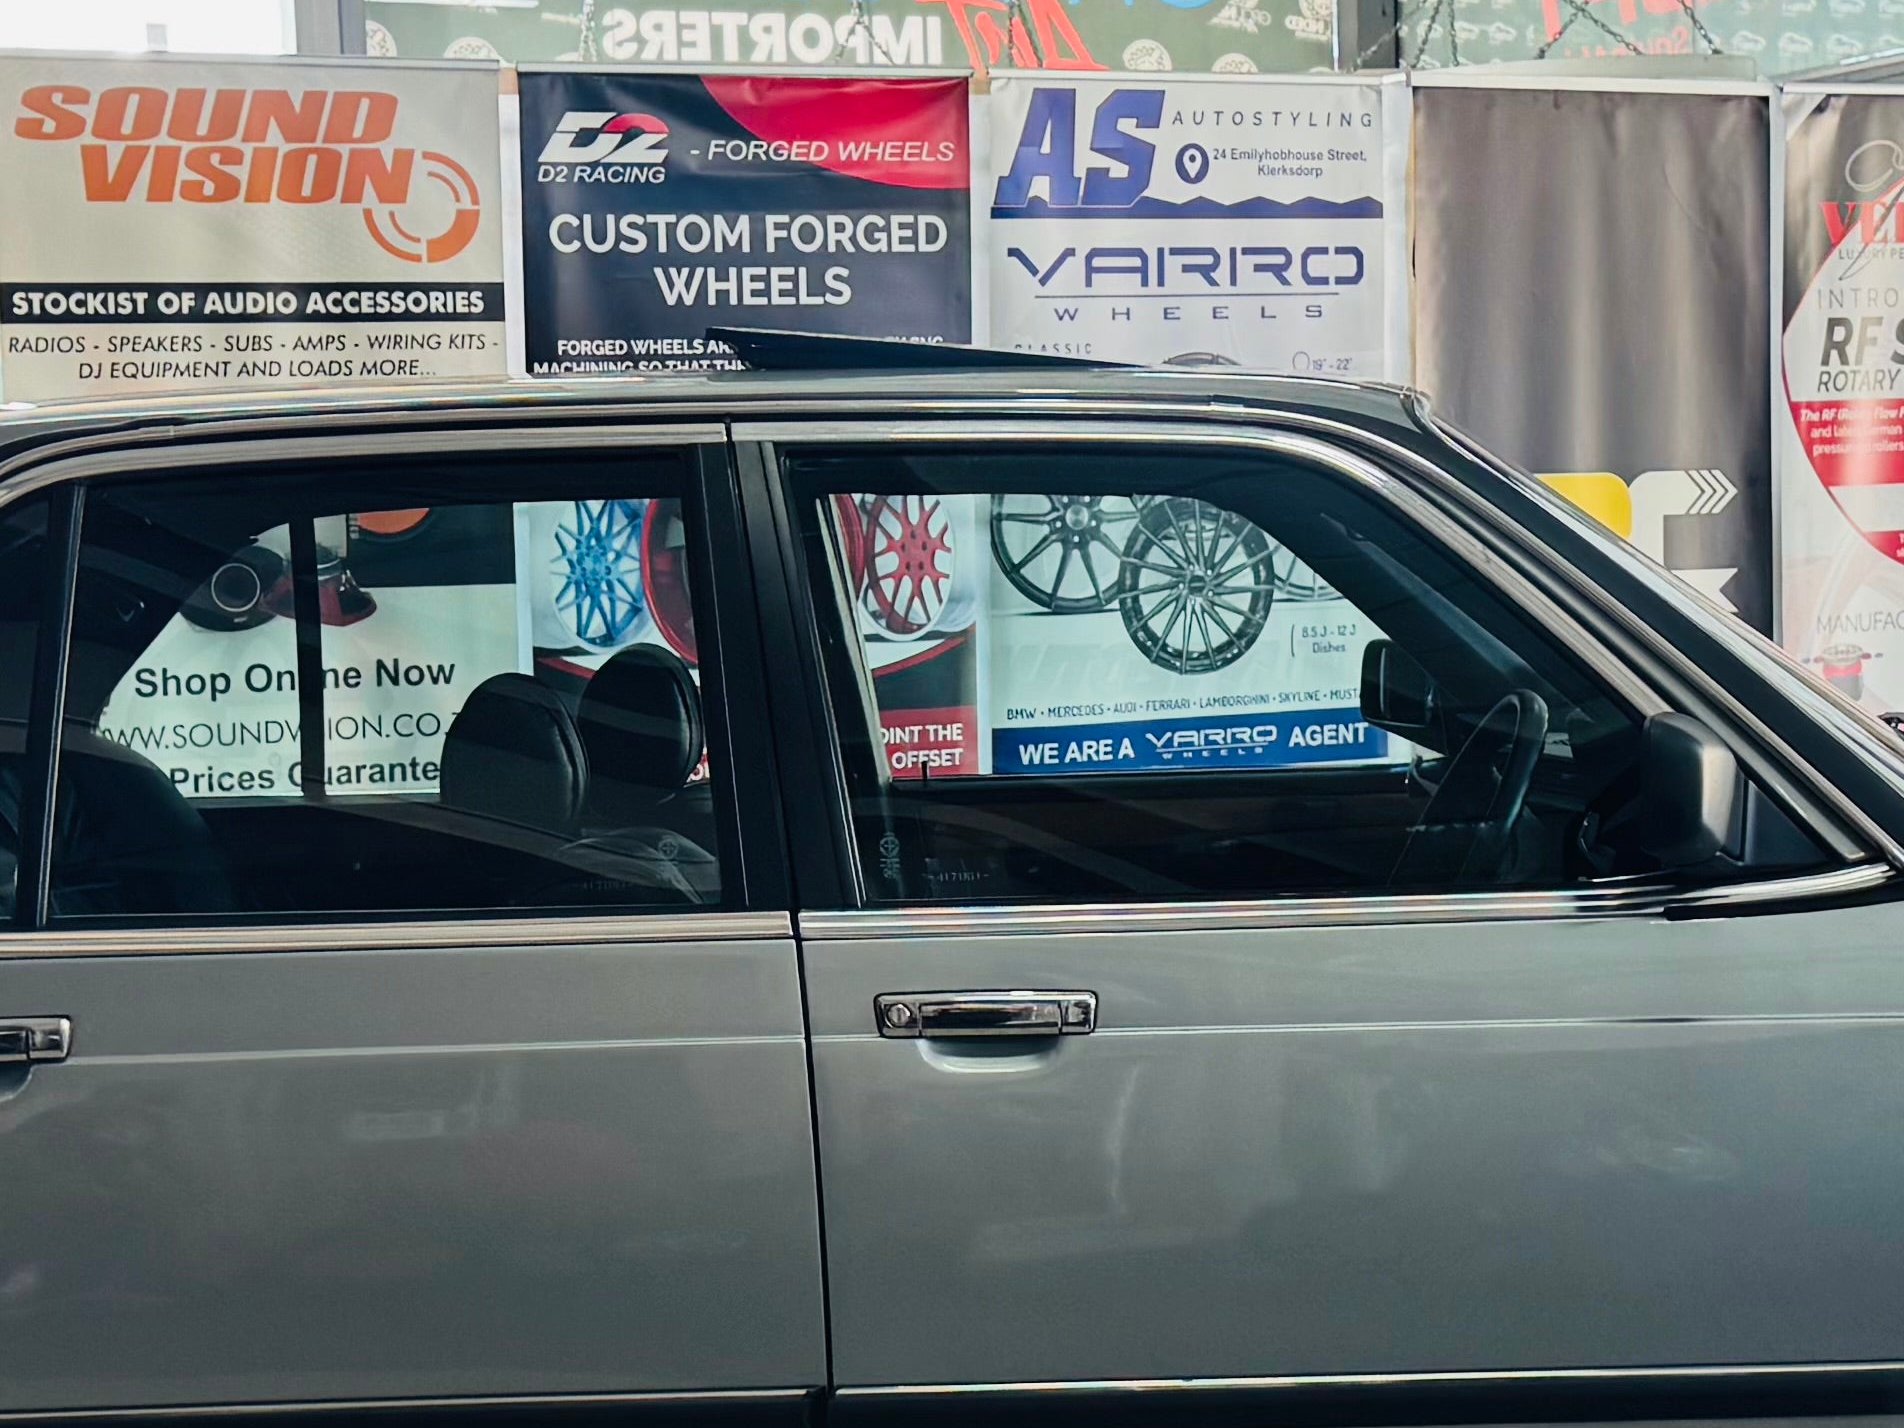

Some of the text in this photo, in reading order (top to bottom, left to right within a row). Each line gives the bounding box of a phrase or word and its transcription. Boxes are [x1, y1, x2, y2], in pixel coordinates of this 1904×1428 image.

[15, 84, 399, 144] SOUND
[1172, 110, 1374, 128] AUTOSTYLING
[537, 110, 670, 164] D2
[993, 87, 1166, 207] AS
[708, 139, 955, 163] FORGED WHEELS
[1213, 148, 1367, 164] 24 Emilyhobhouse Street,
[80, 143, 415, 204] VISION
[538, 166, 667, 184] D2 RACING
[1257, 164, 1324, 179] Klerksdorp
[548, 213, 949, 254] CUSTOM FORGED
[1007, 245, 1365, 289] VARRO
[653, 266, 852, 306] WHEELS
[11, 290, 485, 318] STOCKIST OF AUDIO ACCESSORIES
[1053, 304, 1324, 323] WHEELS
[7, 333, 486, 354] RADIOS SPEAKERS SUBS AMPS WIRING KITS
[557, 339, 704, 356] FORGED WHEELS
[1820, 316, 1884, 368] RF
[78, 360, 105, 380] DJ
[110, 360, 232, 380] EQUIPMENT
[238, 359, 281, 378] AND
[288, 359, 353, 378] LOADS
[1816, 368, 1900, 393] ROTARY
[134, 658, 456, 701] Shop Onne Now
[1007, 707, 1037, 721] BMW
[1047, 703, 1105, 719] MERCEDES
[878, 722, 964, 745] OINT THE
[1019, 721, 1369, 766] WE ARE A VARRO AGENT
[891, 747, 964, 770] OFFSET
[170, 766, 275, 794] Prices
